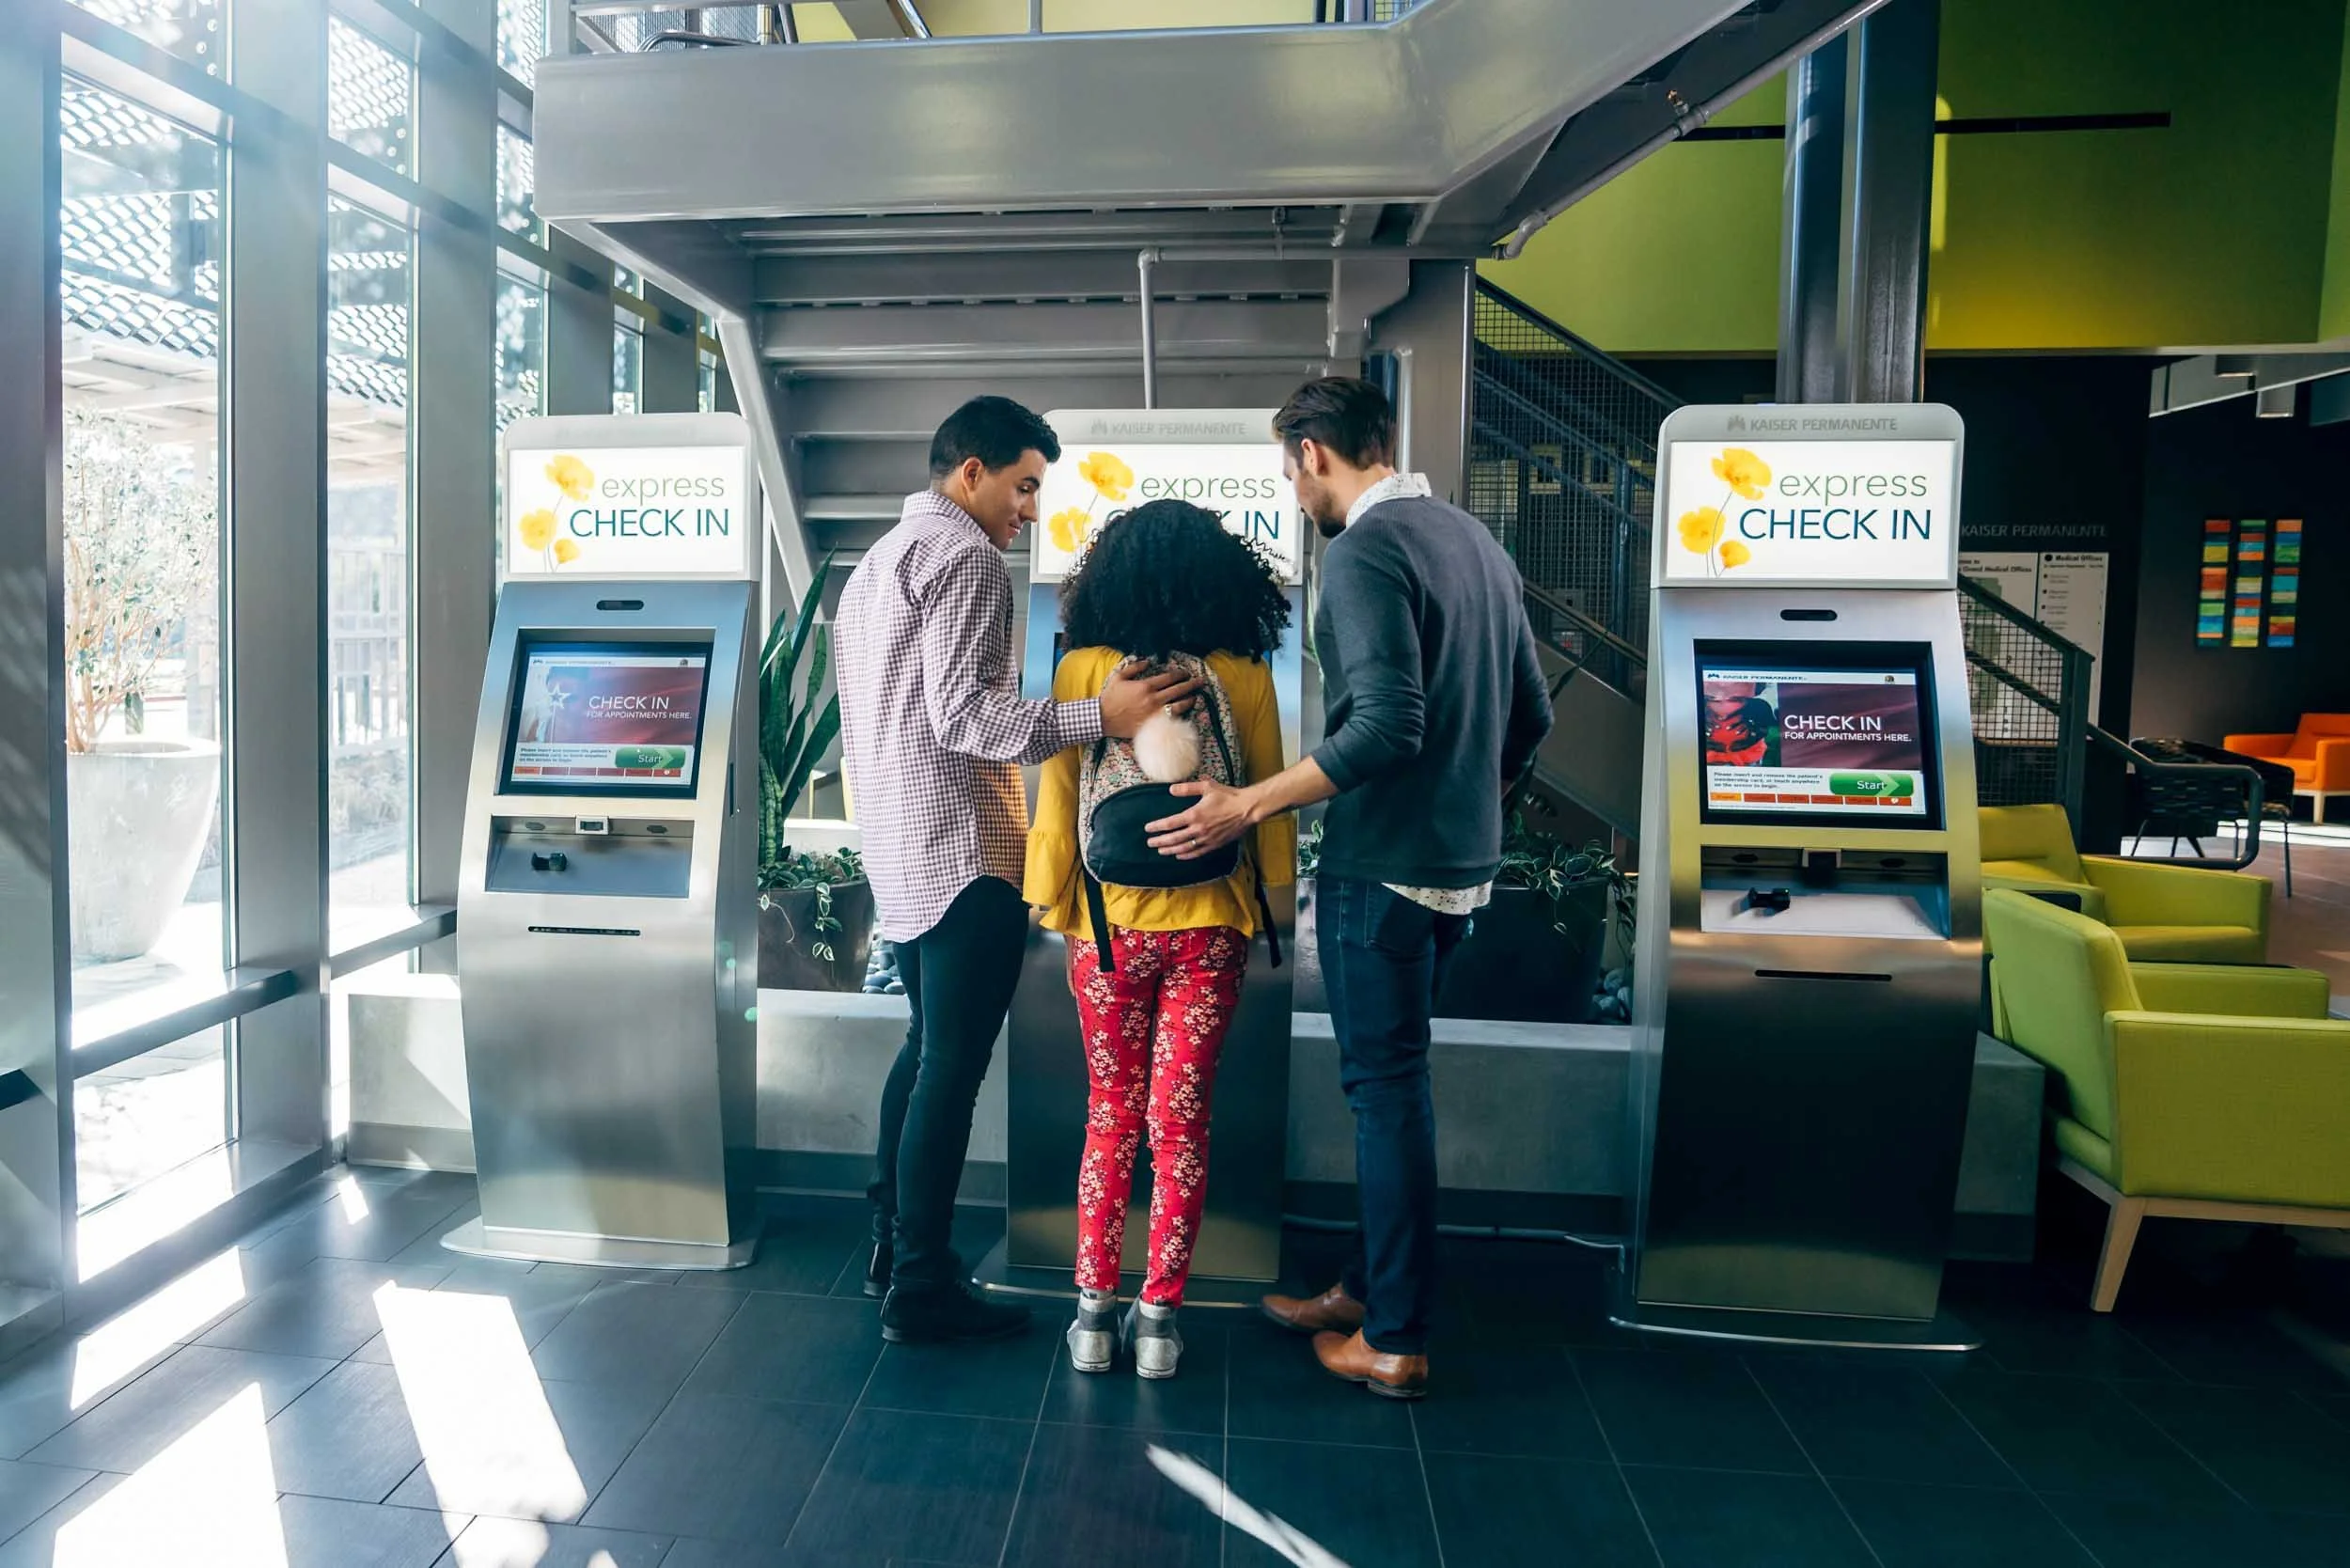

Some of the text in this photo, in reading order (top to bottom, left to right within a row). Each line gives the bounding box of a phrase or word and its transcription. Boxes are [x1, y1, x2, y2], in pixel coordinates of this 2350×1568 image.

[1112, 421, 1248, 435] KAISER PERMANENTE
[1750, 417, 1898, 431] KAISER PERMANENTE
[602, 477, 725, 507] express
[1140, 476, 1276, 499] express
[1779, 474, 1927, 506] express
[570, 508, 728, 537] CHECK IN
[1245, 510, 1279, 540] IN
[1739, 508, 1932, 541] CHECK IN
[1961, 524, 2107, 538] KAISER PERMANENTE
[588, 696, 670, 710] CHECK IN
[587, 711, 692, 719] FOR APPOINTMENTS HERE.
[1783, 714, 1881, 731] CHECK IN
[1783, 731, 1913, 743] FOR APPOINTMENTS HERE.
[637, 754, 664, 764] Start
[1856, 779, 1886, 791] Start
